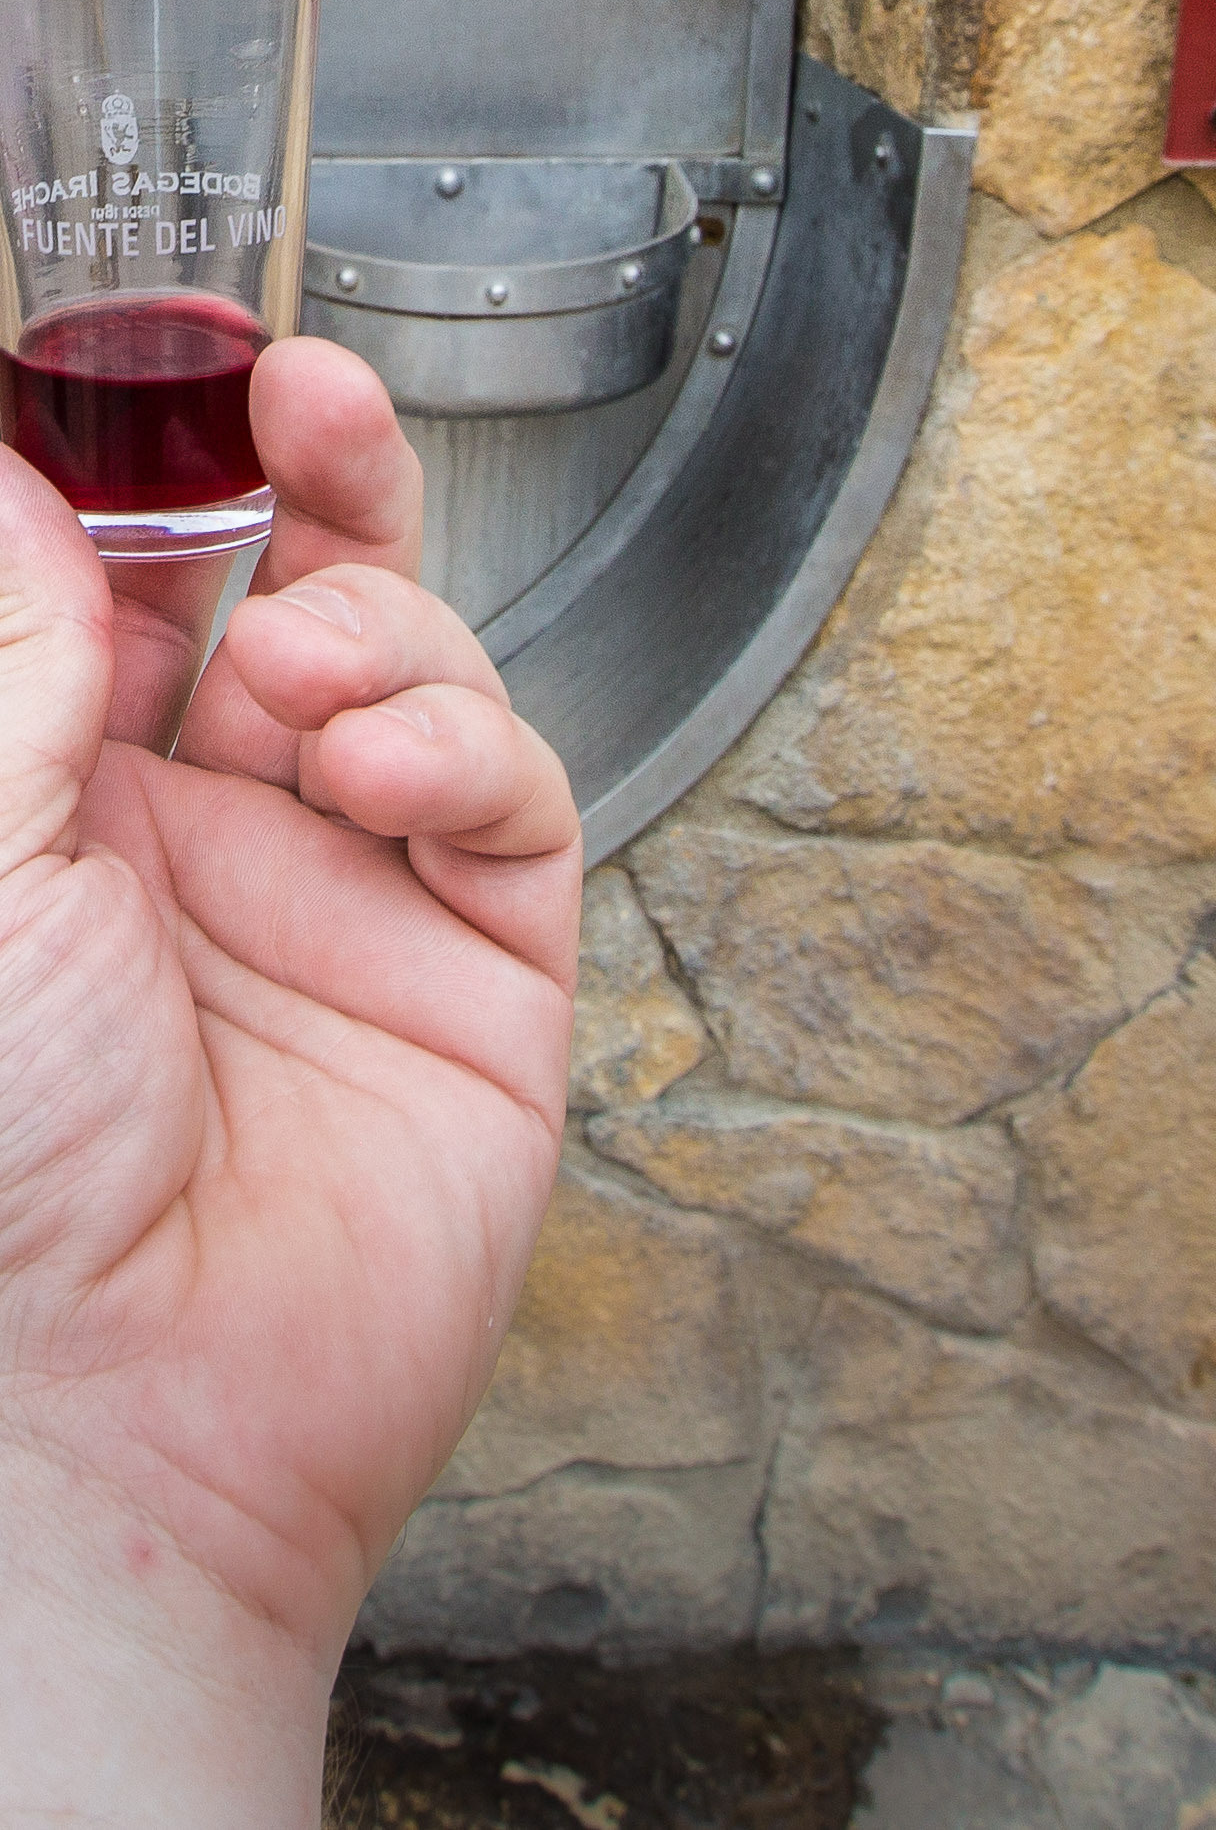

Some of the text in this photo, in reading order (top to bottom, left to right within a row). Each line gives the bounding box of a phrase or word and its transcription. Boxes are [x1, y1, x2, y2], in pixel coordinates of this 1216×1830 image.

[22, 204, 287, 257] FUENTE DEL VINO
